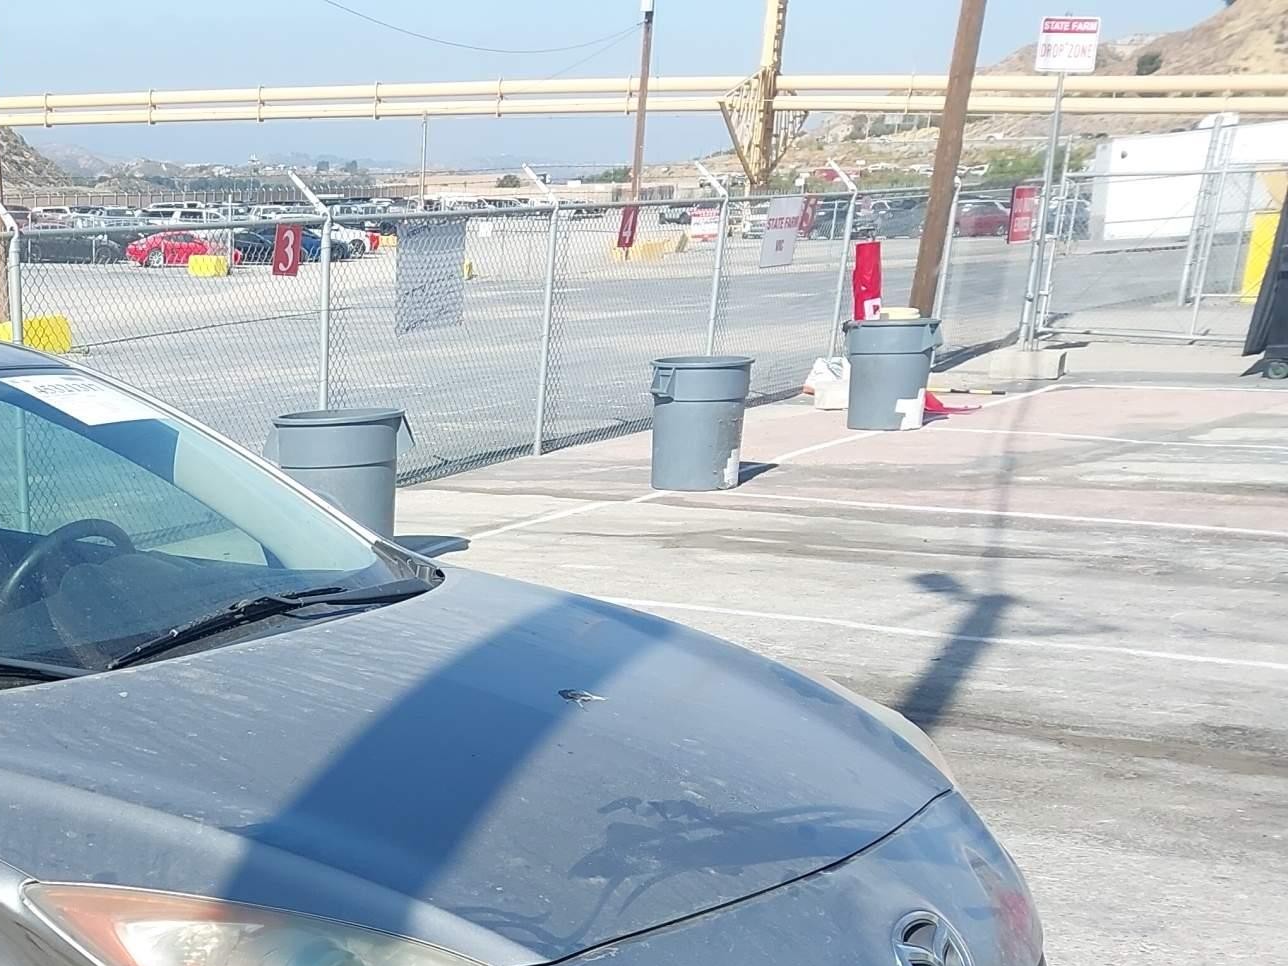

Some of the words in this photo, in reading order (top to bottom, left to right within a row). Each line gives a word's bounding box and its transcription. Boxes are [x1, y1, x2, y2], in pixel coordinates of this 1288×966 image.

[1044, 21, 1070, 31] STATE
[1039, 43, 1064, 58] DROP
[1067, 43, 1093, 58] ZONE
[622, 210, 635, 244] 4
[767, 217, 785, 230] STATE
[278, 229, 295, 272] 3
